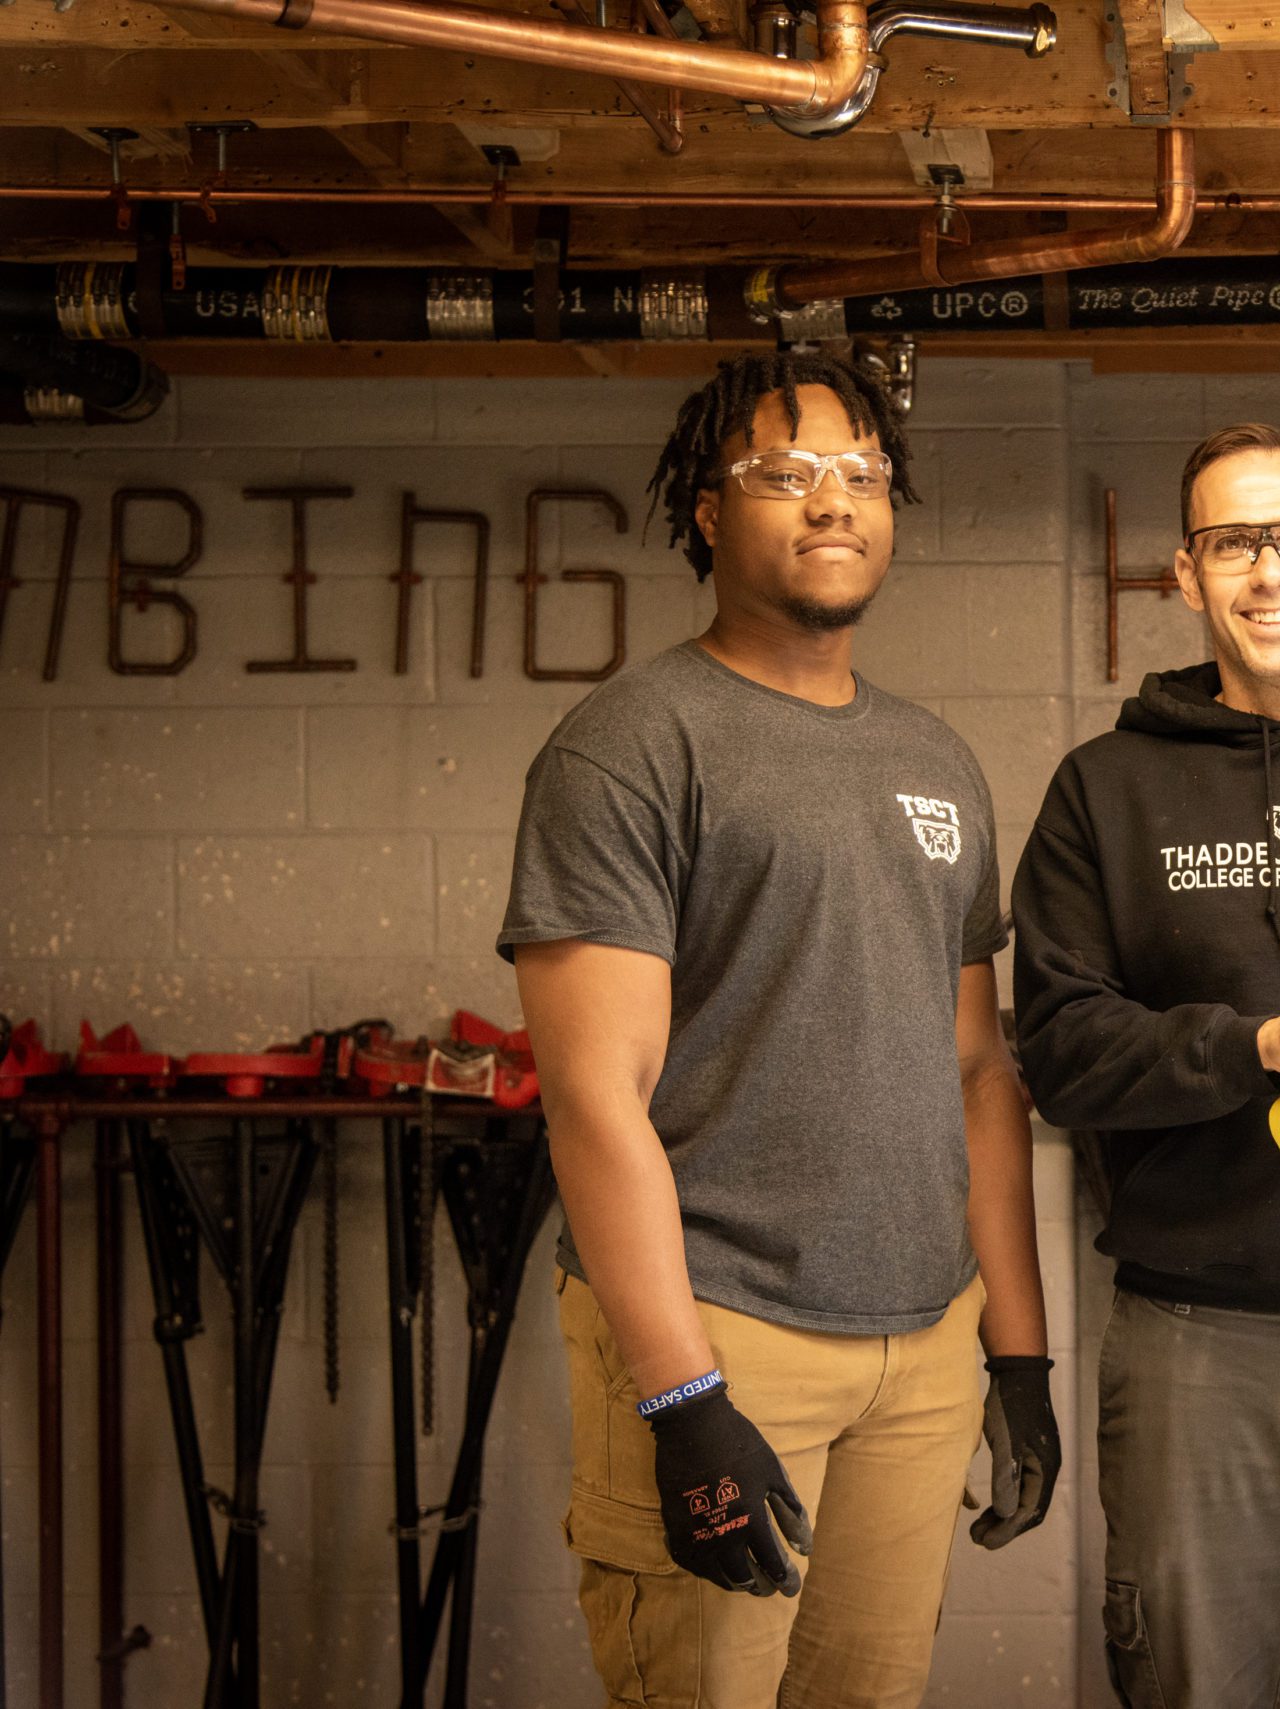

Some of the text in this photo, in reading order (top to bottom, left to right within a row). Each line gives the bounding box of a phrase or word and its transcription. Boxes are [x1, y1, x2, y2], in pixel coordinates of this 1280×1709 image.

[195, 289, 259, 318] USA
[521, 285, 586, 314] 31
[1078, 288, 1122, 310] The
[1130, 286, 1199, 313] Quiet
[896, 793, 961, 827] TSCT
[1168, 867, 1254, 892] COLLEGE
[640, 1370, 723, 1415] UNITED SAFETY
